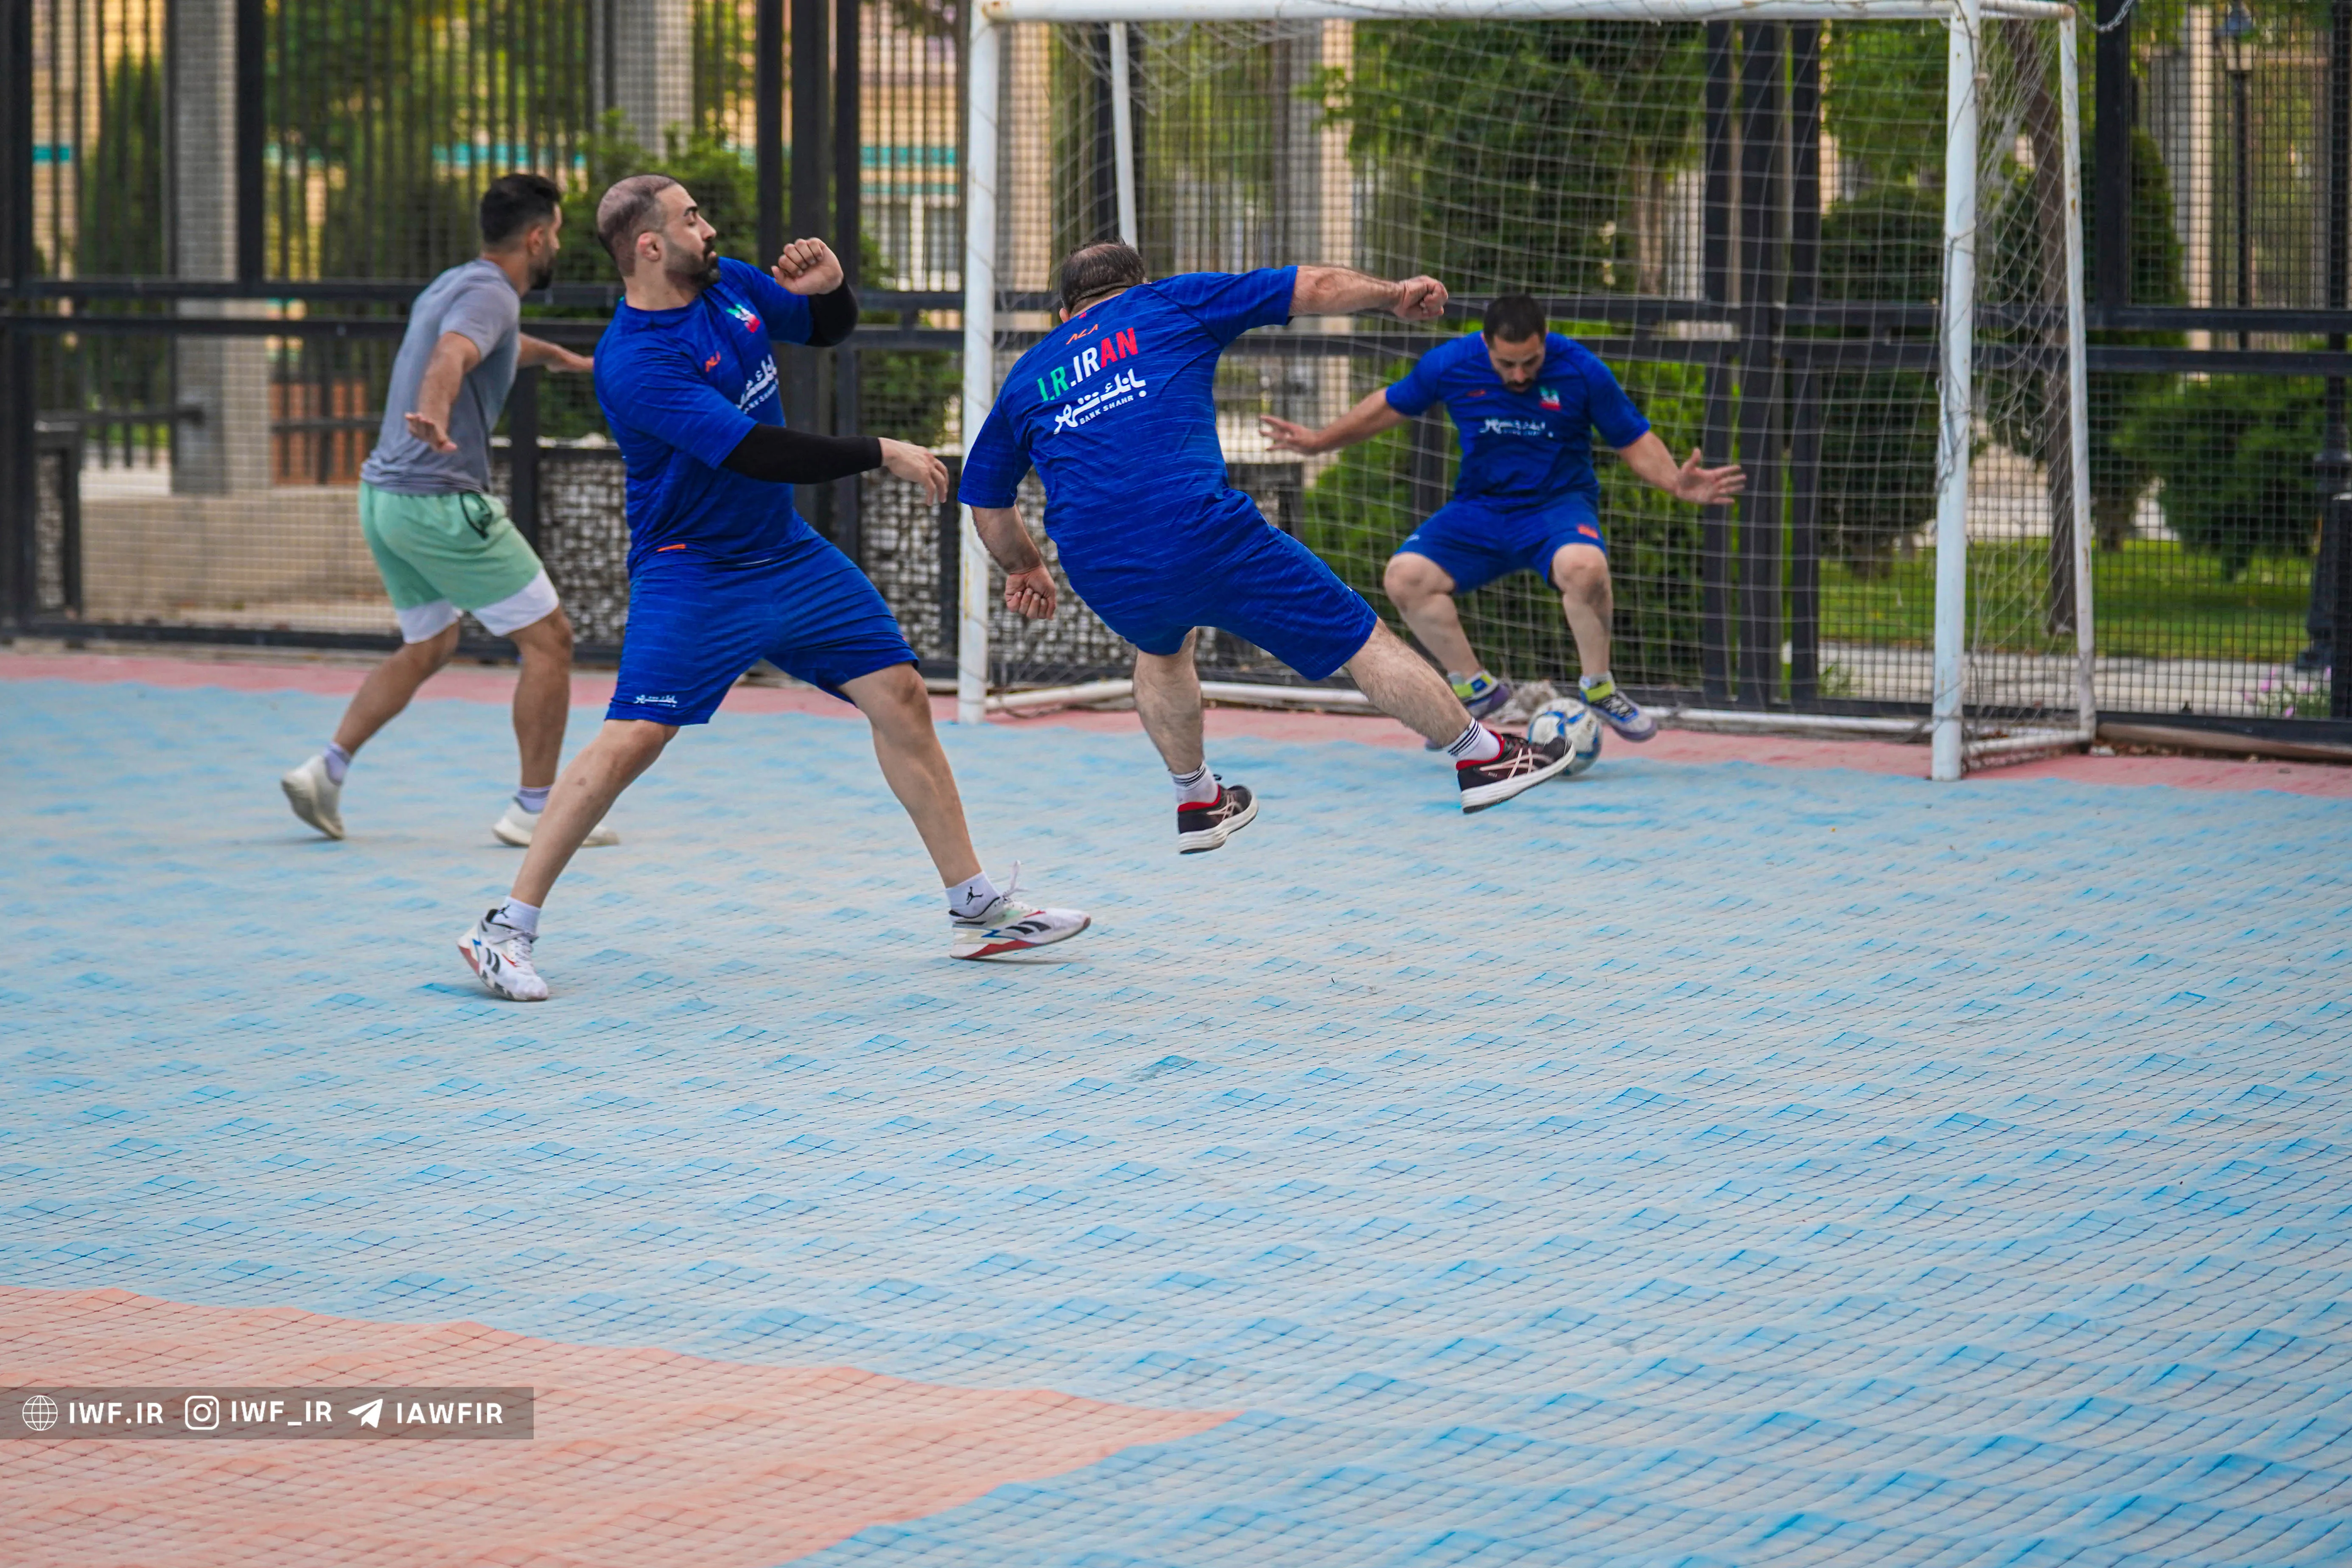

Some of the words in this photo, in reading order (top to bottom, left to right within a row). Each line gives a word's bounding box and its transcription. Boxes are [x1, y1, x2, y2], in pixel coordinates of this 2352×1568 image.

[1053, 392, 1100, 435] شهر
[1079, 409, 1101, 425] BANK
[1103, 395, 1134, 412] SHAHR
